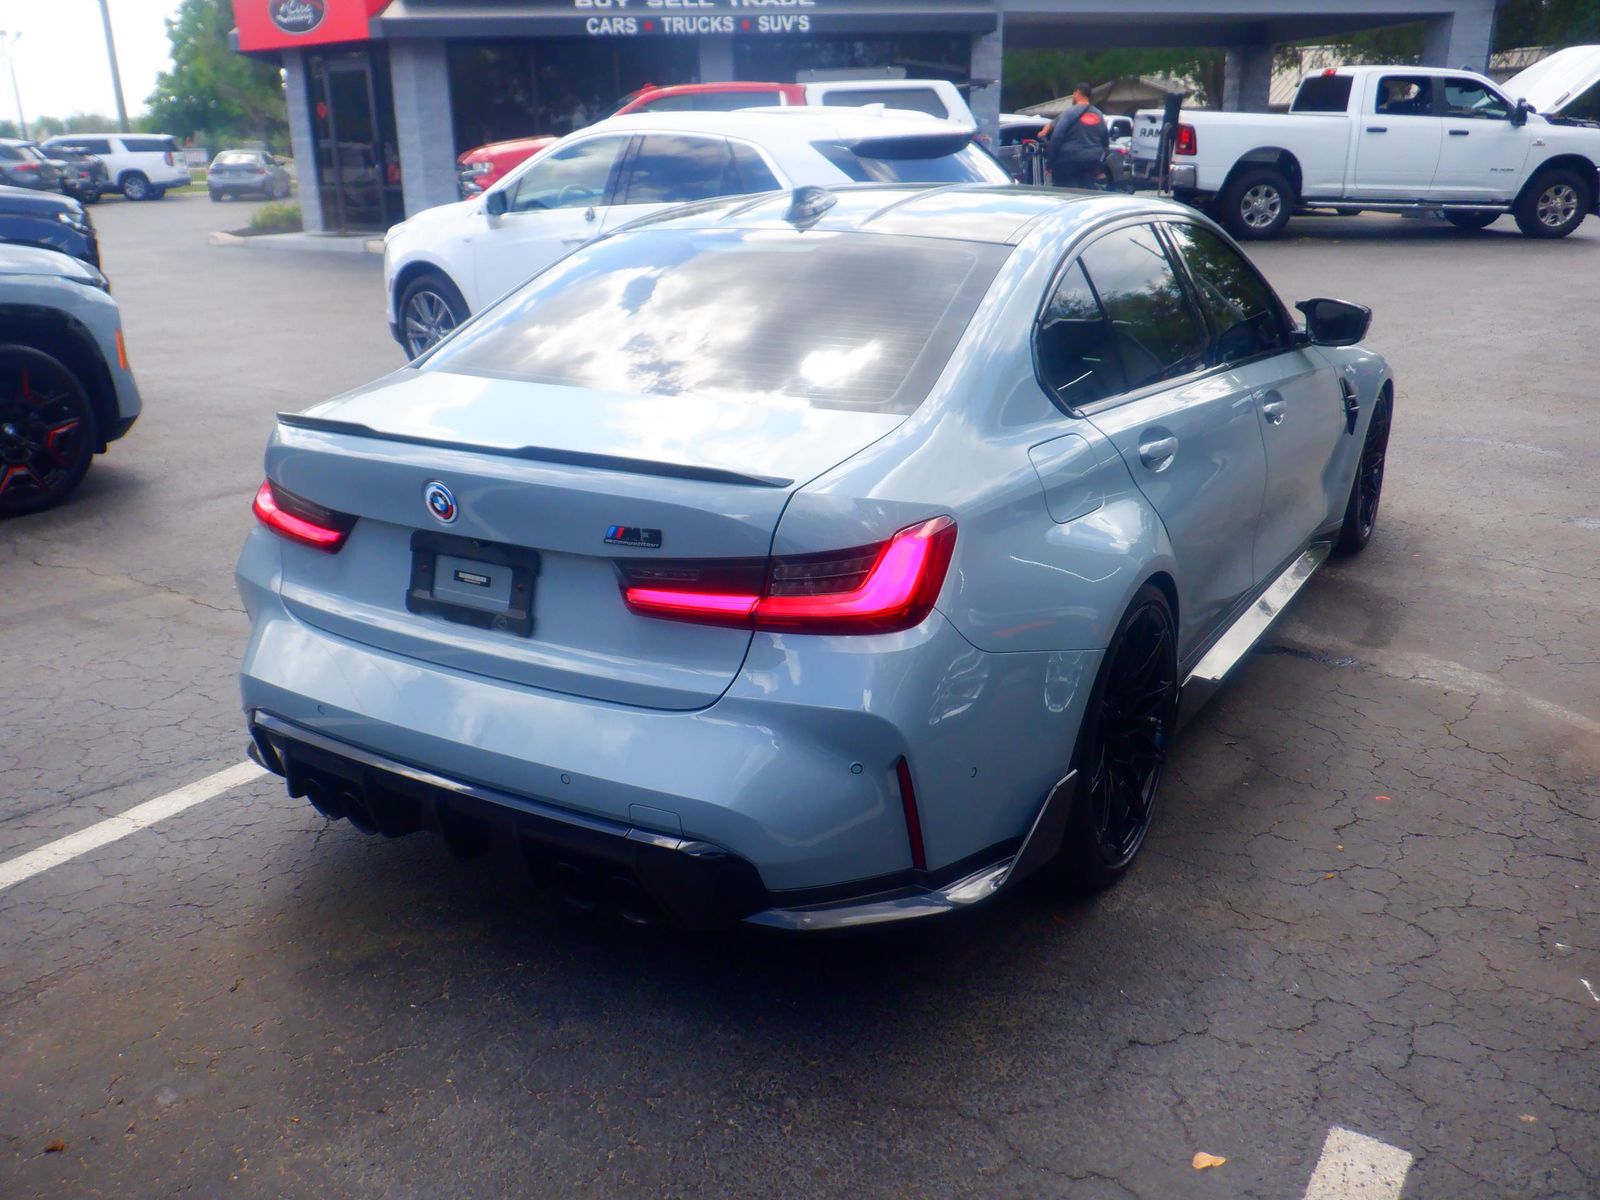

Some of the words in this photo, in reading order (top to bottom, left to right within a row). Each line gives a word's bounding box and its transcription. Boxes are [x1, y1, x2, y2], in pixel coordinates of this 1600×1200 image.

[586, 17, 638, 35] CARS
[661, 16, 735, 33] TRUCKS
[758, 15, 810, 33] SUV'S
